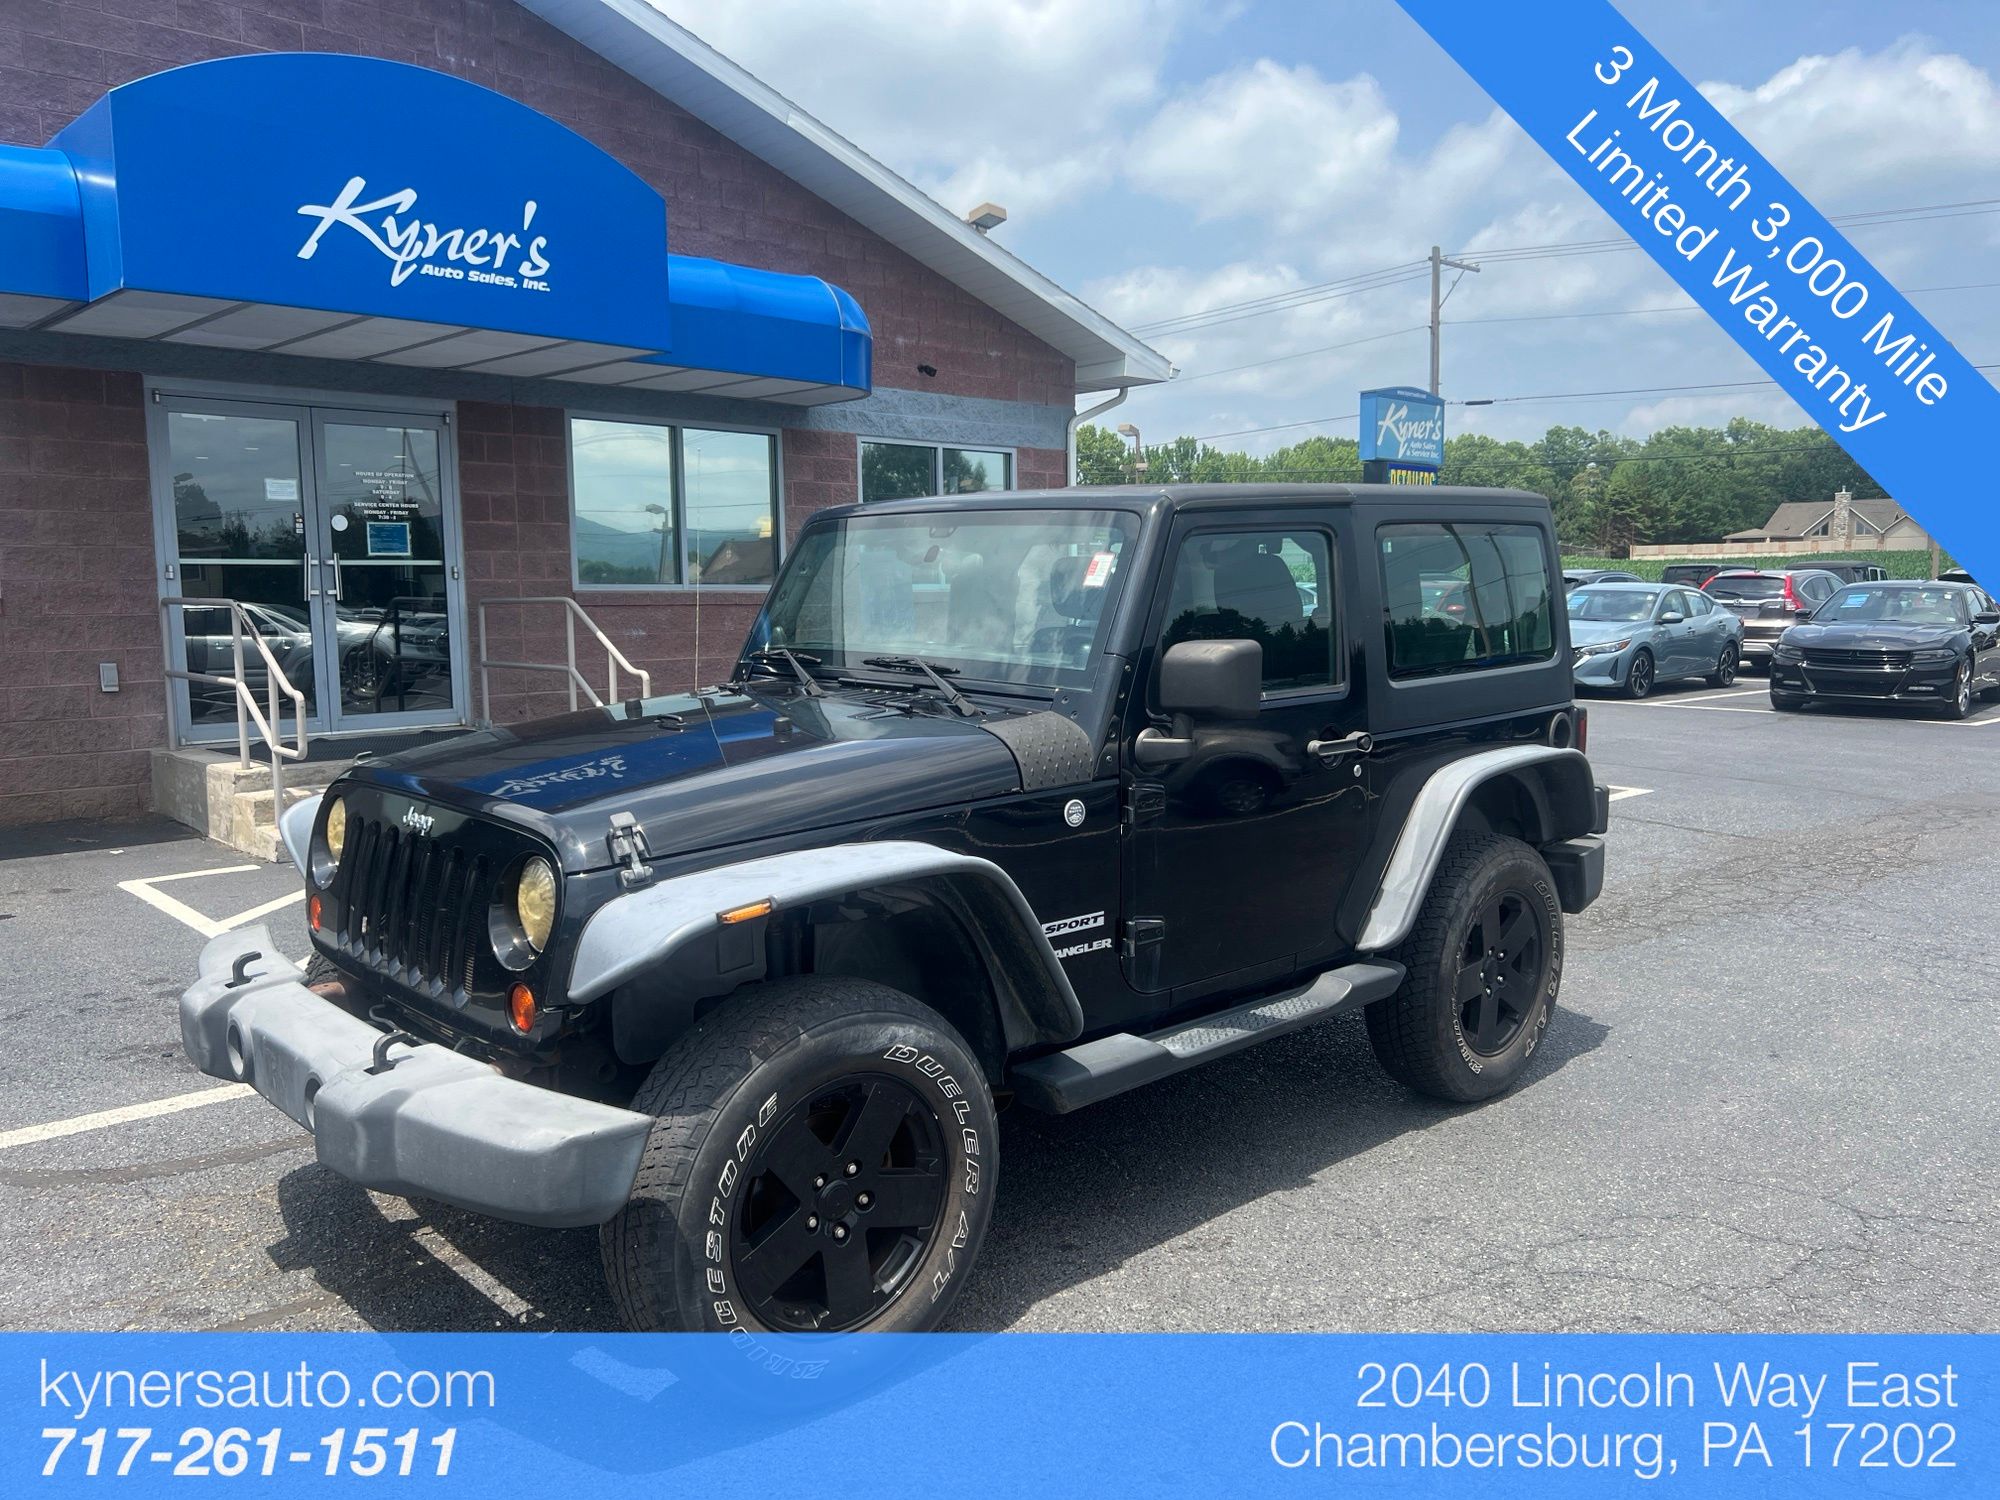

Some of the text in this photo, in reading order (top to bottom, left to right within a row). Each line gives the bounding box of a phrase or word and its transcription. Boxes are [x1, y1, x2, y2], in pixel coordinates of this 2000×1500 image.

[297, 175, 551, 288] Kyner's
[420, 263, 551, 292] Auto Sales, Inc.
[1377, 403, 1441, 459] Kyner's
[402, 806, 435, 837] Jeep
[1045, 916, 1101, 935] SPORT
[1054, 938, 1112, 958] ANGLER
[883, 1044, 980, 1195] DUELER
